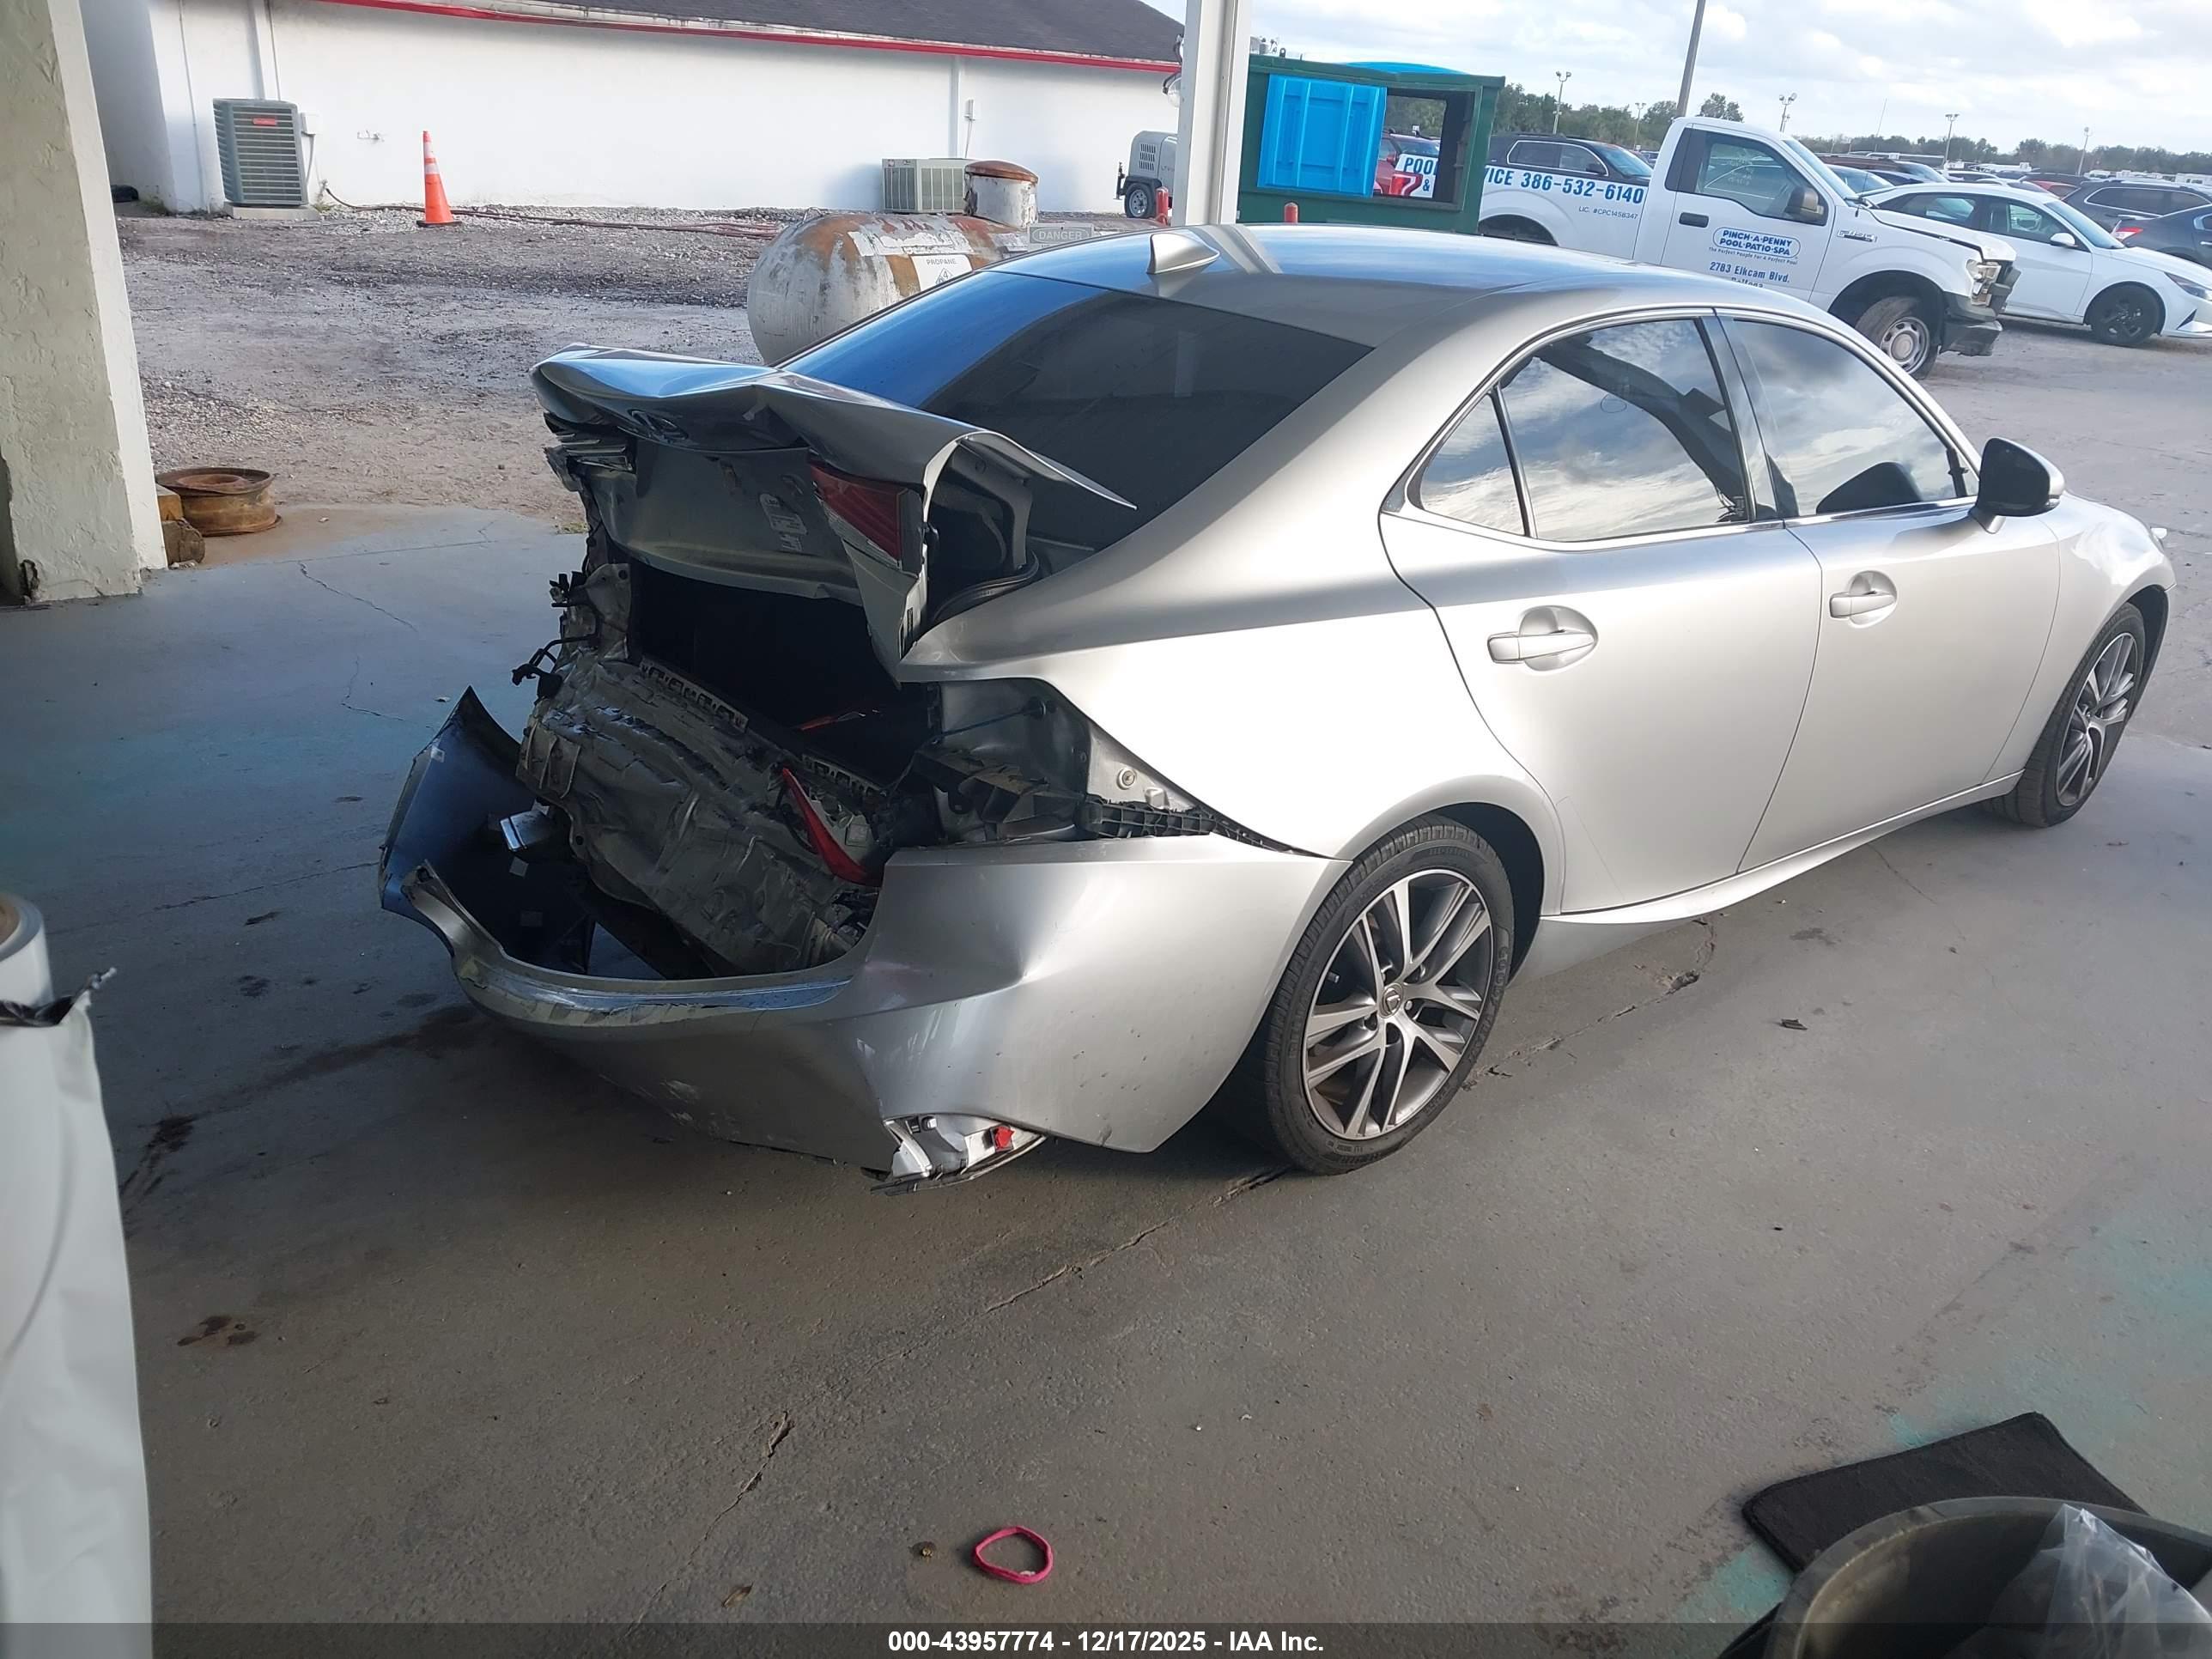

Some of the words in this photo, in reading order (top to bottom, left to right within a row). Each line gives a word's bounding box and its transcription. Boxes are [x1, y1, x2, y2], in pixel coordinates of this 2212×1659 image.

[1423, 179, 1431, 191] &
[1521, 173, 1644, 204] 386-532-6140
[1038, 230, 1082, 241] DANGER
[1710, 261, 1732, 273] 2783
[1735, 265, 1766, 279] Elkcam
[1769, 270, 1790, 283] Blvd.
